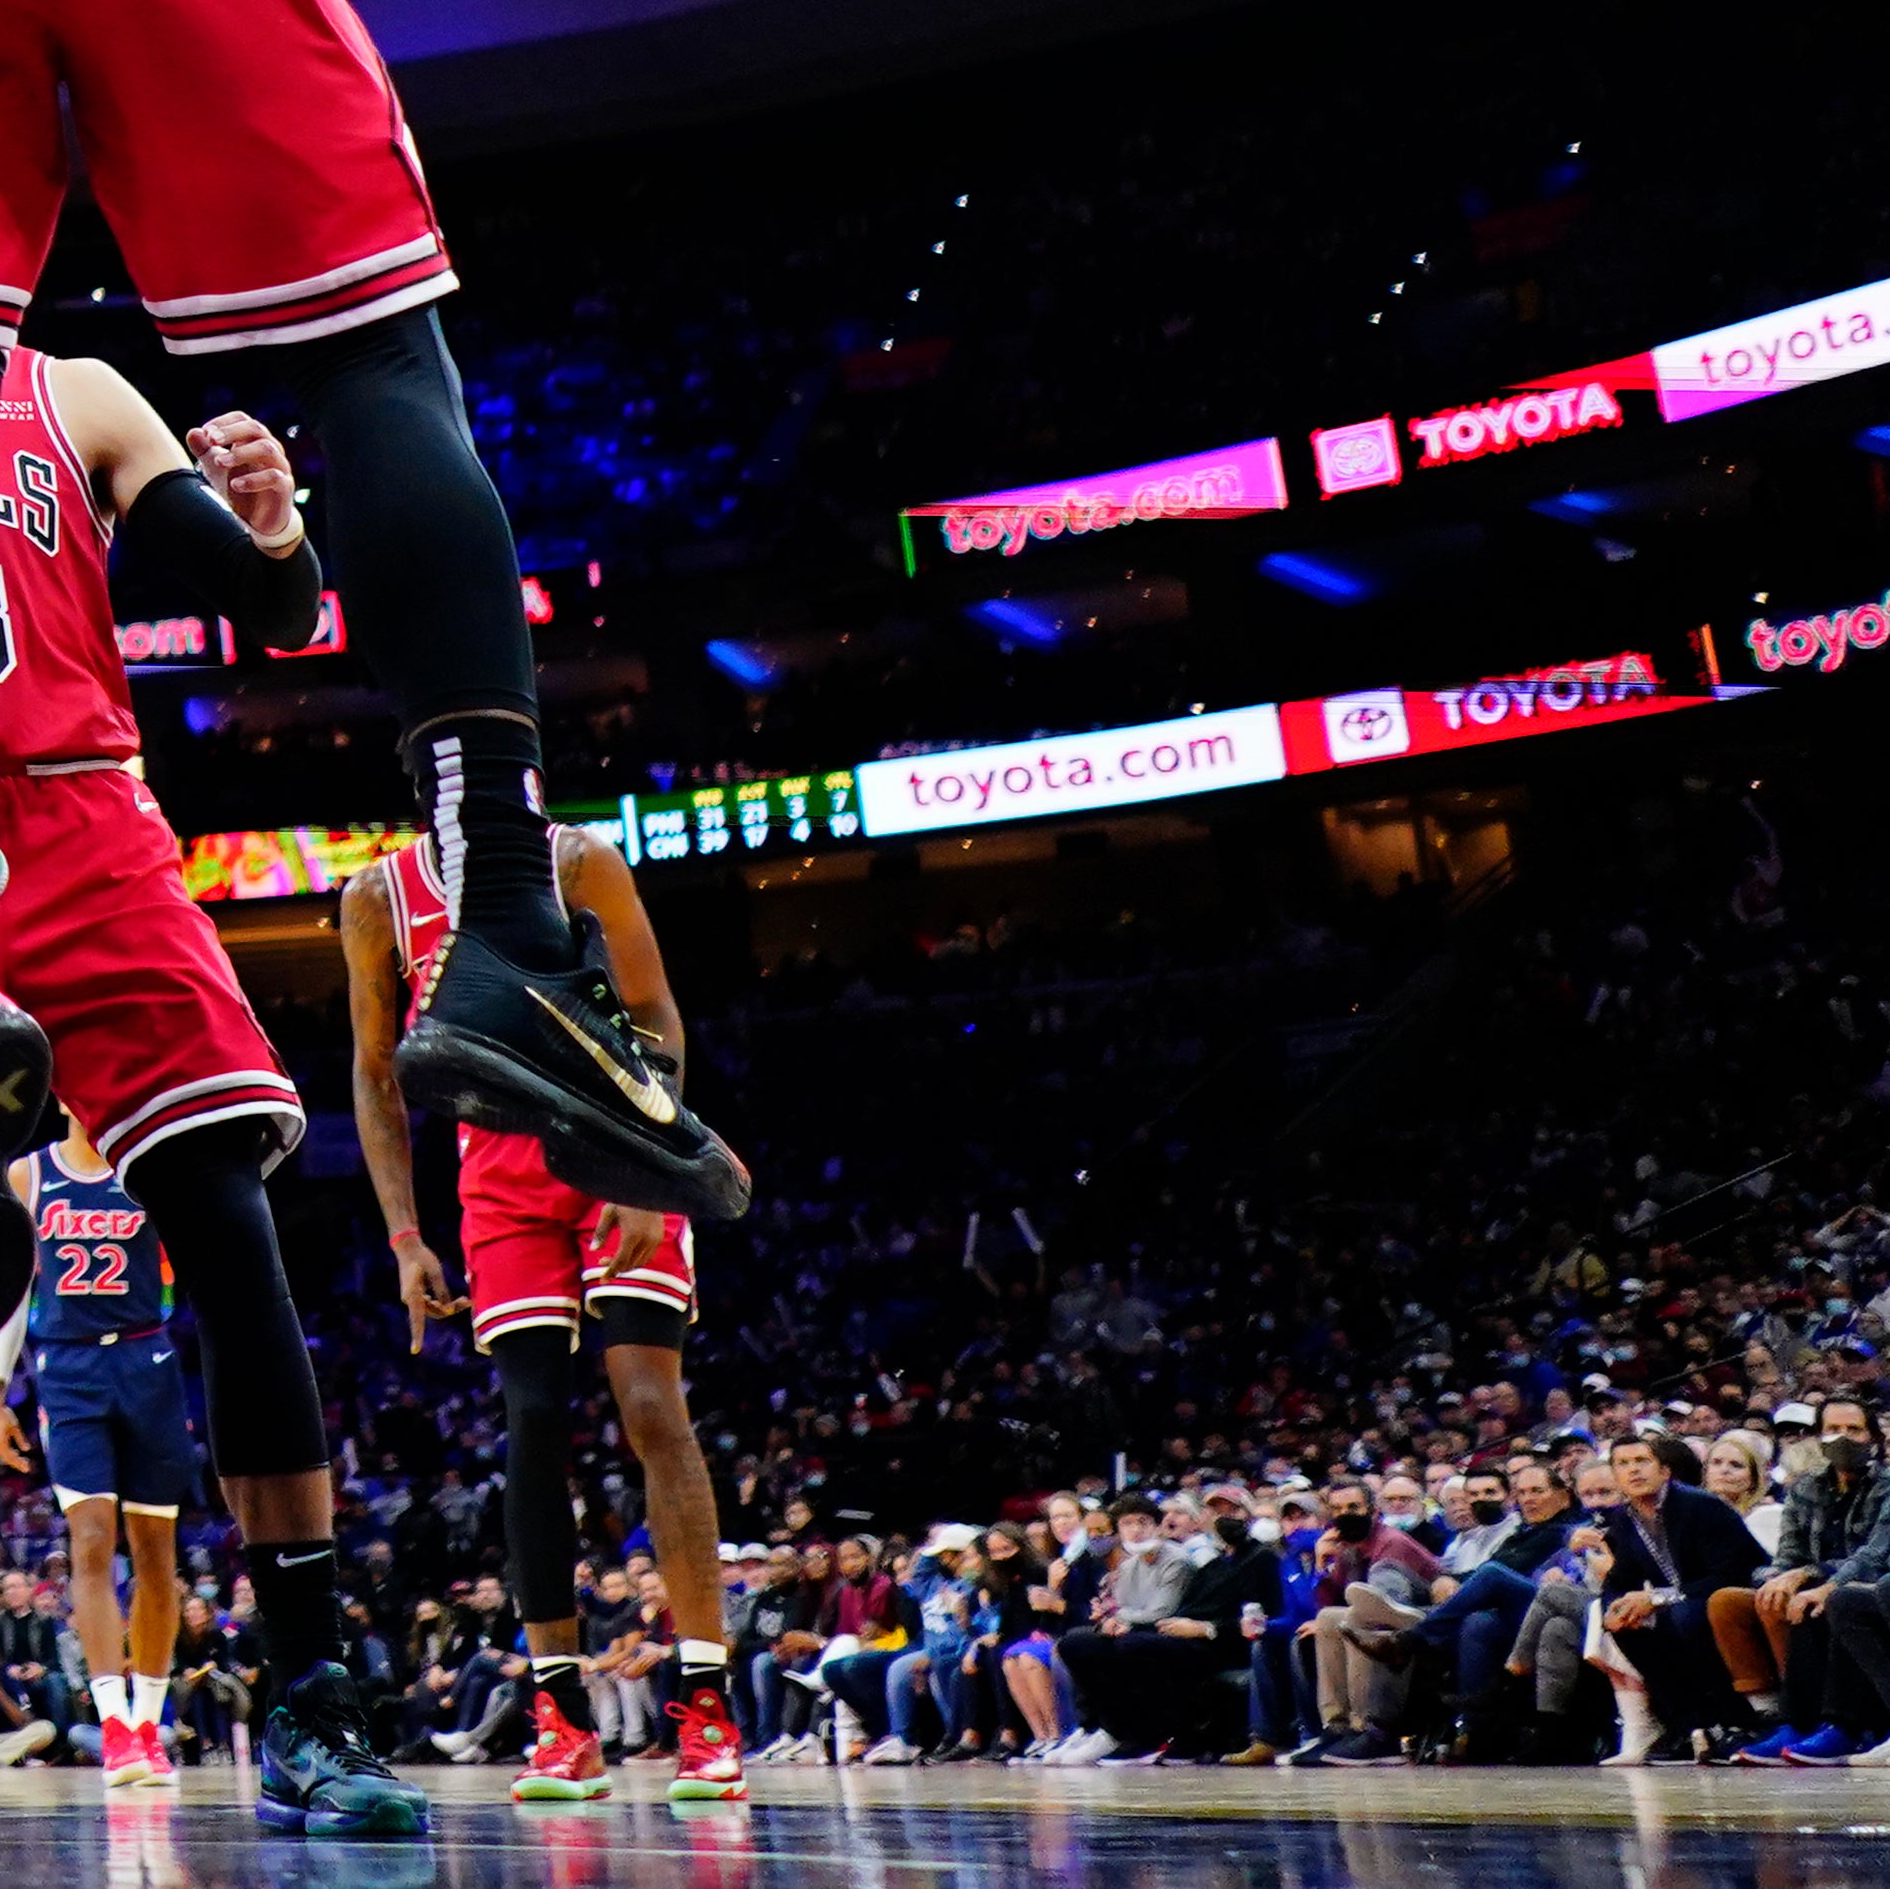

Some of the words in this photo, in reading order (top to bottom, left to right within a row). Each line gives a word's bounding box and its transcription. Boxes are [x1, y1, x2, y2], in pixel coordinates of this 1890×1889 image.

[1700, 304, 1890, 389] toyota.
[1414, 383, 1619, 464] TOYOTA
[942, 461, 1242, 557] toyota.com
[1432, 652, 1655, 729] TOYOTA
[907, 726, 1236, 812] toyota.com
[643, 810, 685, 837] PHI
[699, 806, 725, 831] 31
[741, 800, 768, 826] 21
[788, 796, 806, 819] 3
[833, 790, 847, 812] 7
[646, 833, 689, 859] CHI
[699, 828, 729, 853] 39
[743, 824, 769, 848] 17
[791, 818, 810, 841] 4
[829, 812, 858, 837] 10
[38, 1200, 148, 1242] Sixers
[55, 1242, 129, 1297] 22
